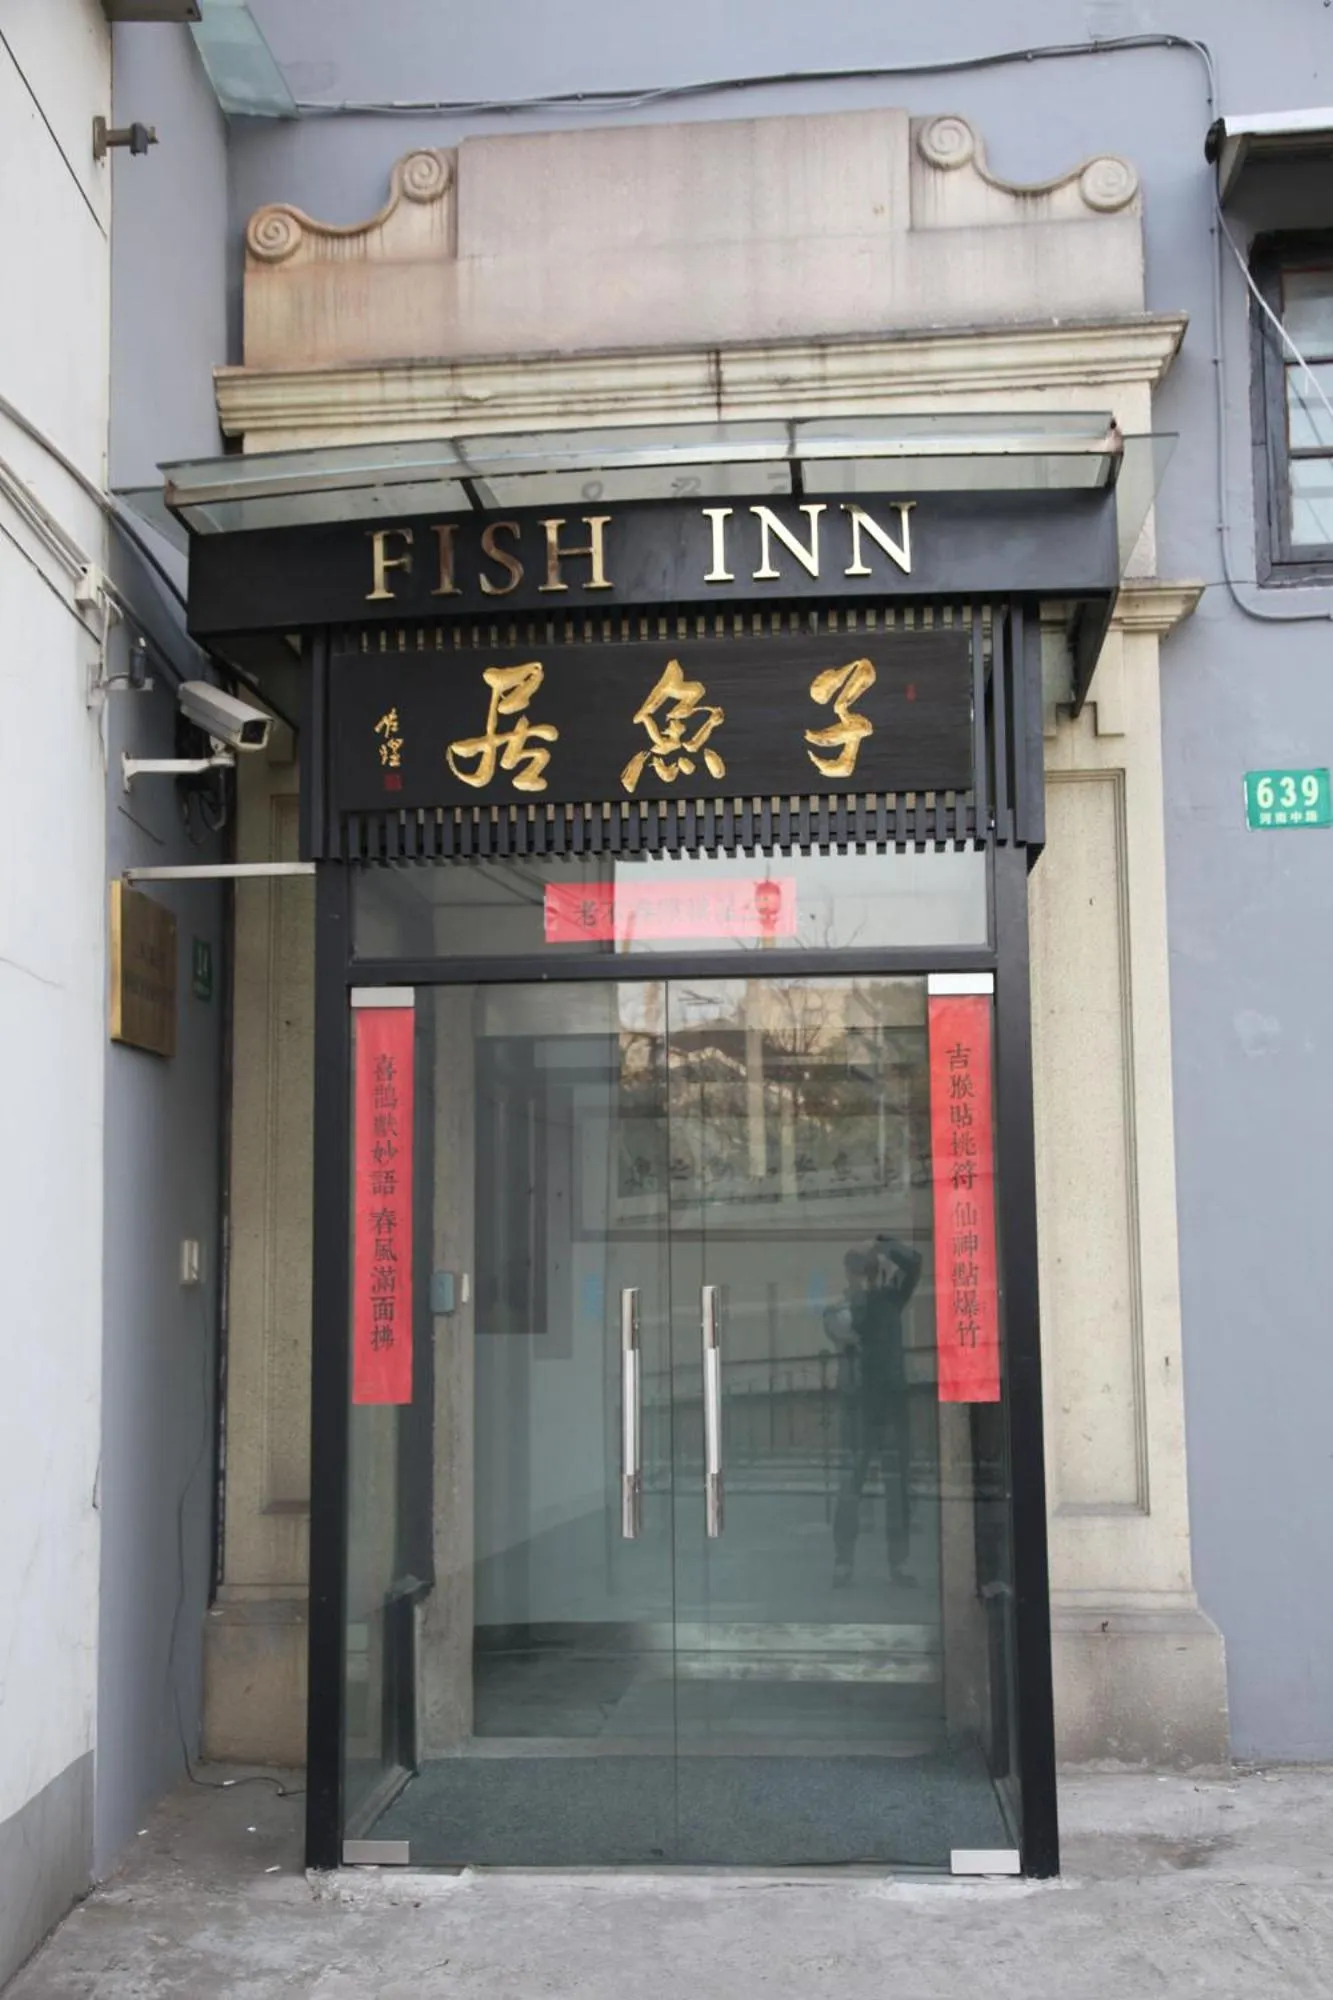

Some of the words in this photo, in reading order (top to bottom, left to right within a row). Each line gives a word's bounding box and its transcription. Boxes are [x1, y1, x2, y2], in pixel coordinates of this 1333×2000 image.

[366, 516, 615, 600] FISH
[703, 502, 917, 581] INN
[1257, 775, 1319, 808] 639
